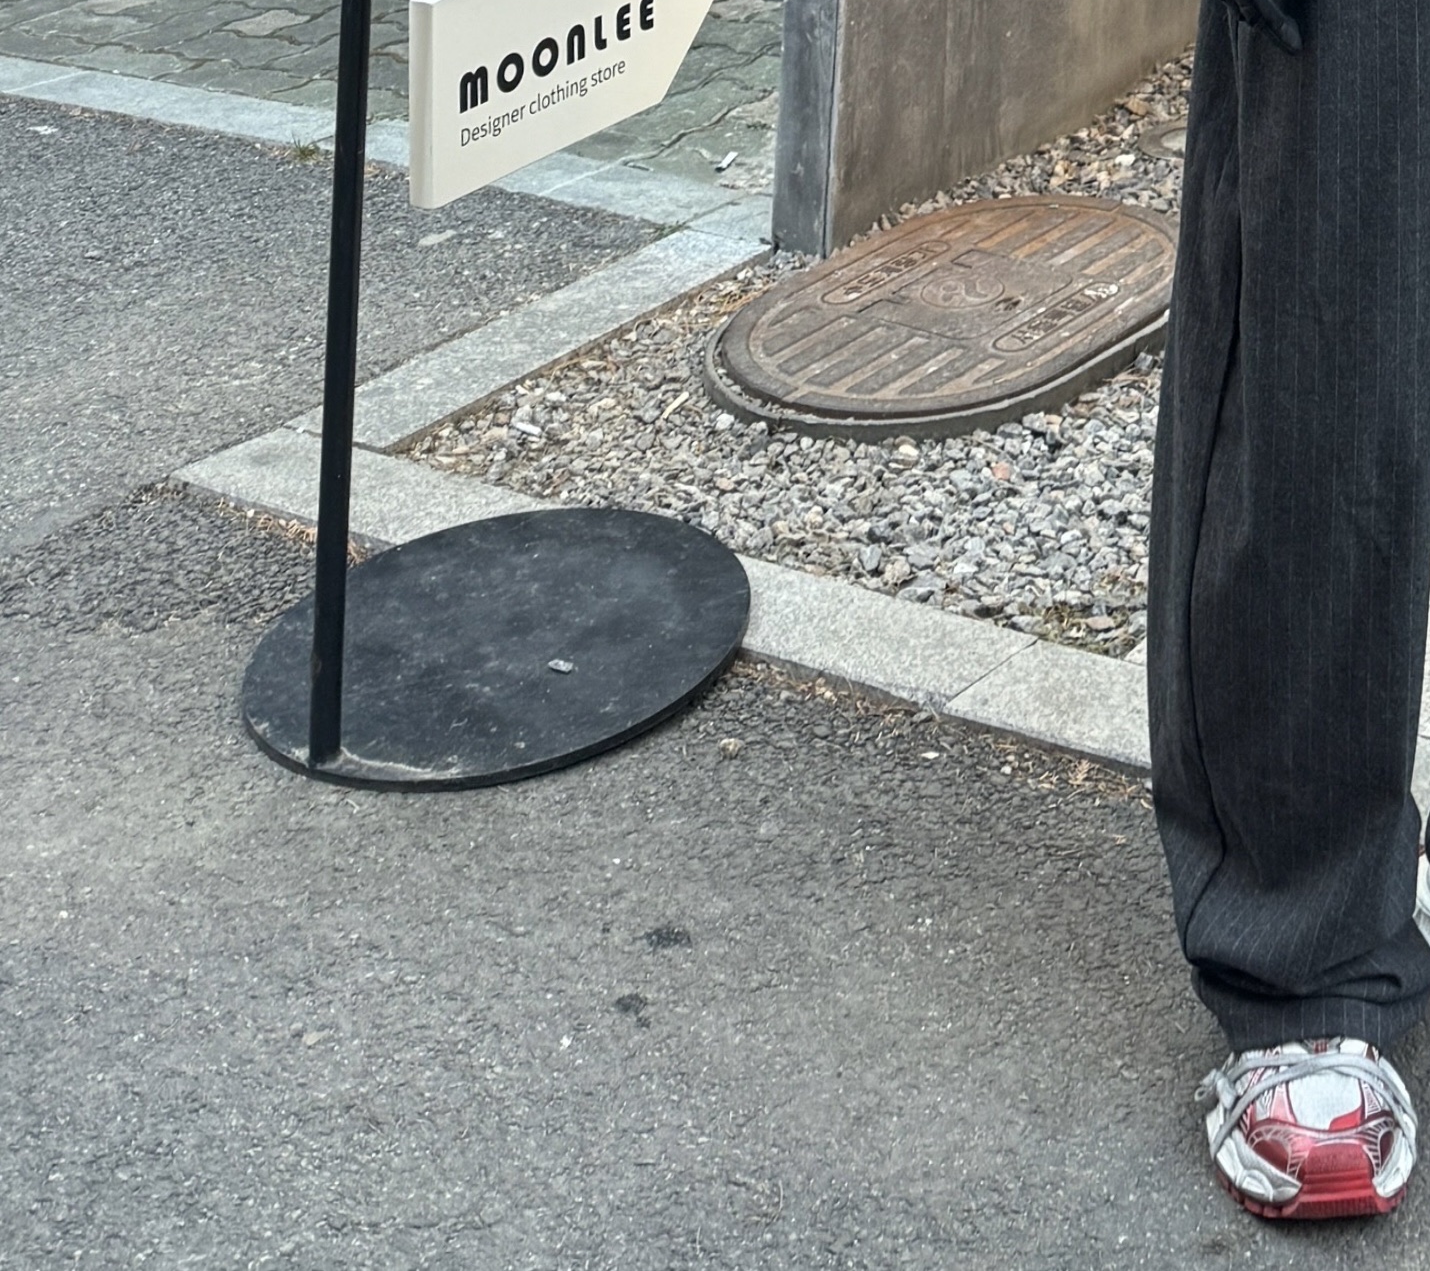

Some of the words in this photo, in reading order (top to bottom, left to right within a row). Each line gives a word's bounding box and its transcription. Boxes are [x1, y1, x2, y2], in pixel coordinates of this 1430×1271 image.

[461, 104, 526, 147] Designer
[529, 77, 588, 115] clothing
[591, 60, 626, 88] store
